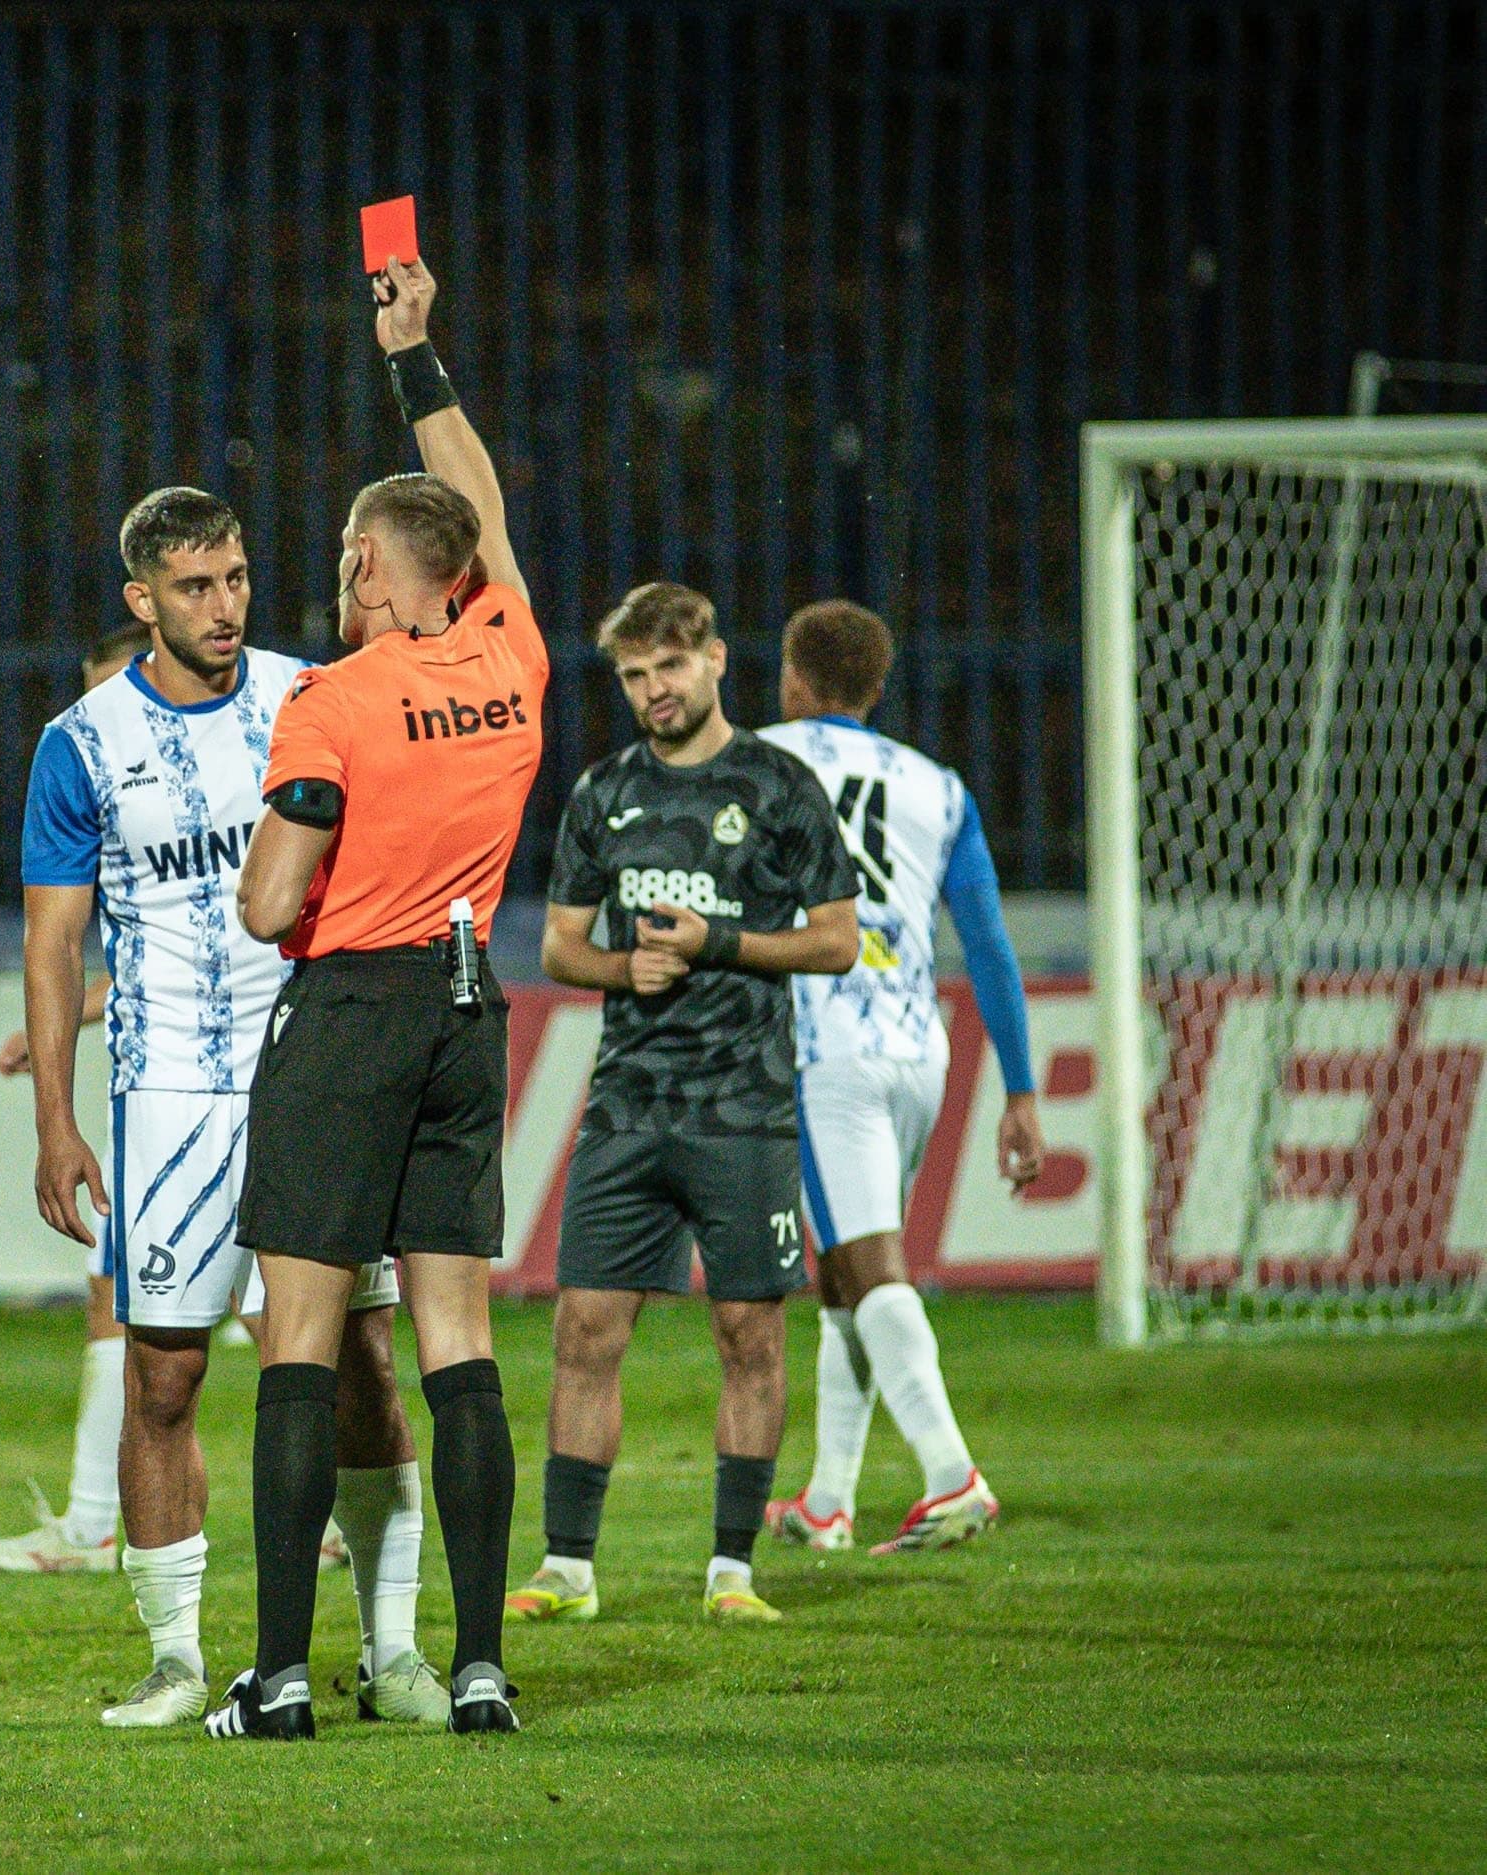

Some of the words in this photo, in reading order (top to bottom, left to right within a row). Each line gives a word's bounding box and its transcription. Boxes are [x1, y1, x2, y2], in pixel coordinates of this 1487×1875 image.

[400, 689, 528, 741] inbet
[121, 775, 159, 790] erima
[143, 821, 256, 883] WIN
[769, 1208, 799, 1248] 71
